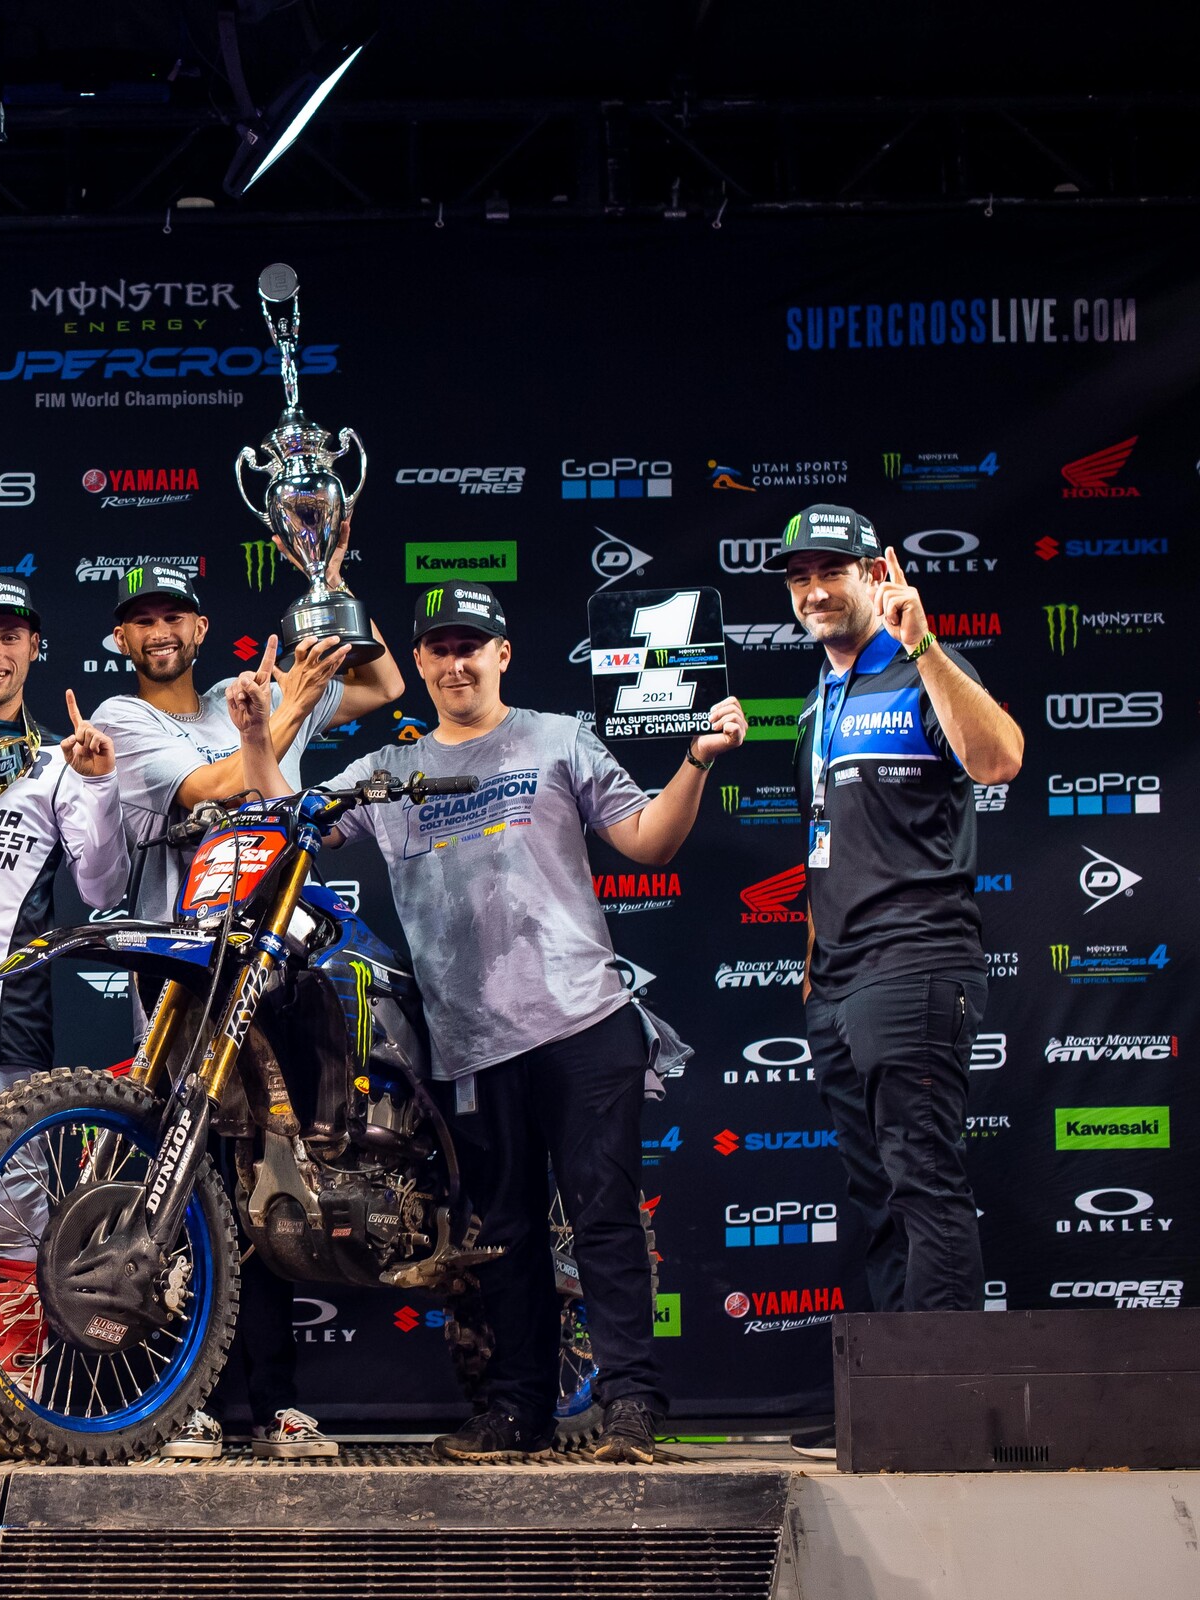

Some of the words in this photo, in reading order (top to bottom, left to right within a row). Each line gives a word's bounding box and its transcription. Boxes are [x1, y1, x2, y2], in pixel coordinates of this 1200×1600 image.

[64, 319, 207, 333] ENERGY
[786, 298, 1137, 351] SUPERCROSSLIVE.COM
[35, 392, 66, 408] FIM
[71, 391, 119, 407] World
[125, 390, 244, 408] Championship
[561, 458, 673, 477] GoPro
[753, 463, 791, 474] UTAH
[796, 462, 848, 473] SPORTS
[978, 452, 999, 476] 4
[109, 469, 199, 492] YAMAHA
[396, 467, 526, 484] COOPER
[753, 473, 847, 486] COMMISSION
[459, 482, 524, 494] TIRES
[1062, 487, 1141, 499] HONDA
[101, 494, 135, 509] Revs
[819, 515, 851, 524] YAMAHA
[1066, 538, 1168, 556] SUZUKI
[17, 554, 38, 578] 4
[95, 556, 133, 567] ROCKY
[416, 552, 506, 569] Kawasaki
[906, 558, 998, 573] AKLEY
[1082, 612, 1165, 626] MONSTER
[598, 653, 640, 667] AMA
[642, 692, 673, 702] 2021
[1046, 692, 1163, 729] WPS
[605, 717, 626, 725] AMA
[627, 714, 690, 725] SUPERCROSS
[856, 711, 913, 731] YAMAHA
[605, 725, 640, 736] EAST
[888, 767, 921, 777] YAMAHA
[1049, 773, 1161, 793] GoPro
[419, 781, 537, 822] CHAMPION
[420, 820, 444, 832] COLT
[445, 808, 487, 826] NICHOLS
[239, 848, 275, 862] SX
[1148, 944, 1171, 969] 4
[736, 961, 773, 972] ROCKY
[1064, 1035, 1104, 1046] ROCKY
[1105, 1034, 1170, 1046] MOUNTAIN
[724, 1067, 815, 1085] OAKLE
[1067, 1120, 1159, 1136] Kawasaki
[660, 1126, 684, 1152] 4
[146, 1108, 192, 1215] DUNLOP
[725, 1202, 837, 1224] GoPro
[1055, 1219, 1173, 1233] OAKLEY
[1050, 1280, 1184, 1298] COOPER
[753, 1287, 845, 1316] YAMAHA
[1115, 1297, 1180, 1308] TIRES
[87, 1326, 122, 1344] SPEED
[93, 1318, 128, 1336] LIGHT
[744, 1319, 781, 1336] Revs
